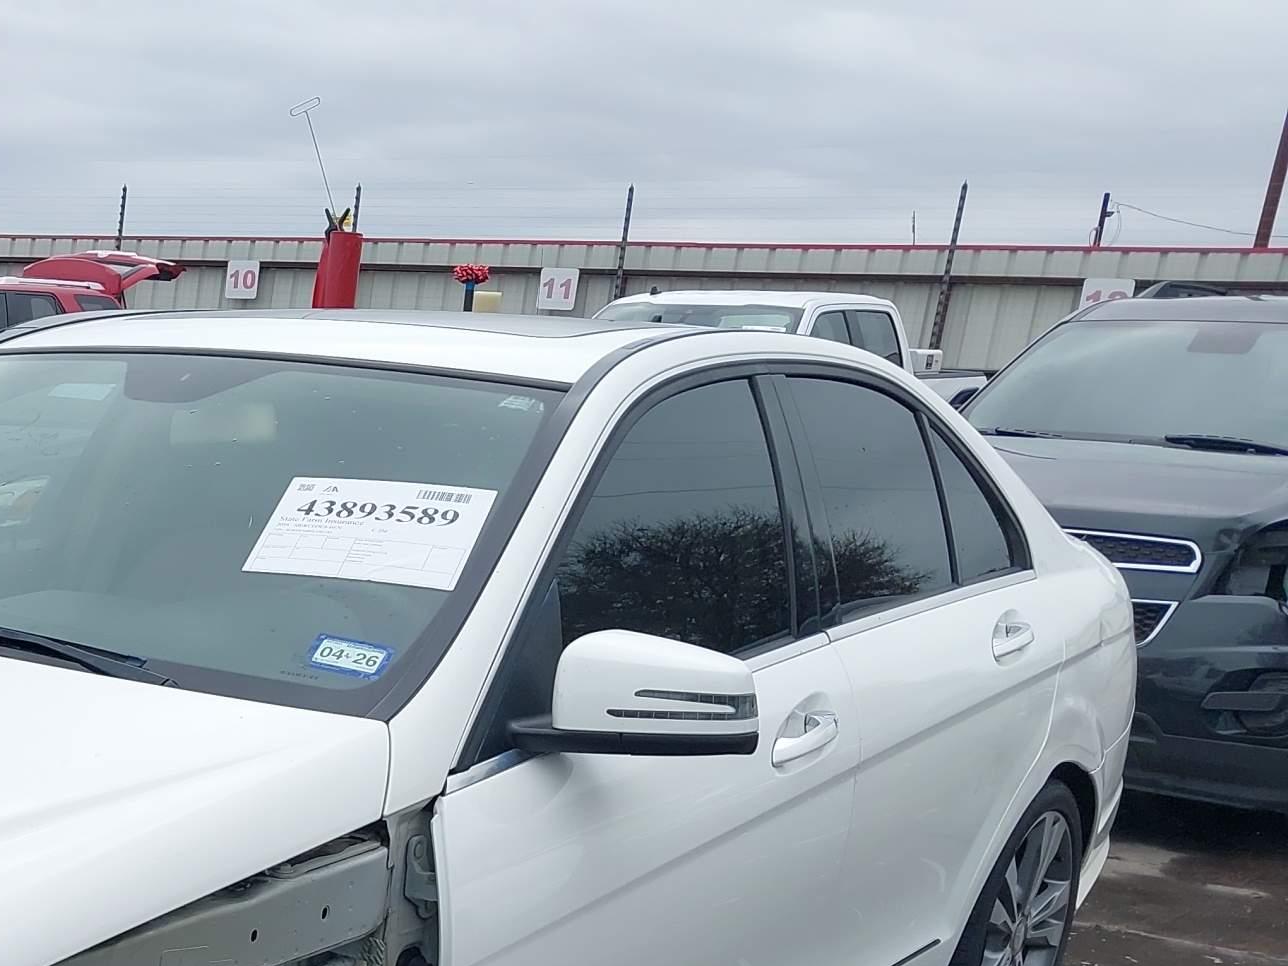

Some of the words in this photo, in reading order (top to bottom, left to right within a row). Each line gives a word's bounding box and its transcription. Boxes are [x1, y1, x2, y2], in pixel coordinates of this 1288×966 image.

[229, 269, 256, 290] 10
[543, 277, 573, 300] 11
[296, 499, 460, 527] 43893589
[319, 646, 345, 661] 04
[352, 652, 380, 668] 26
